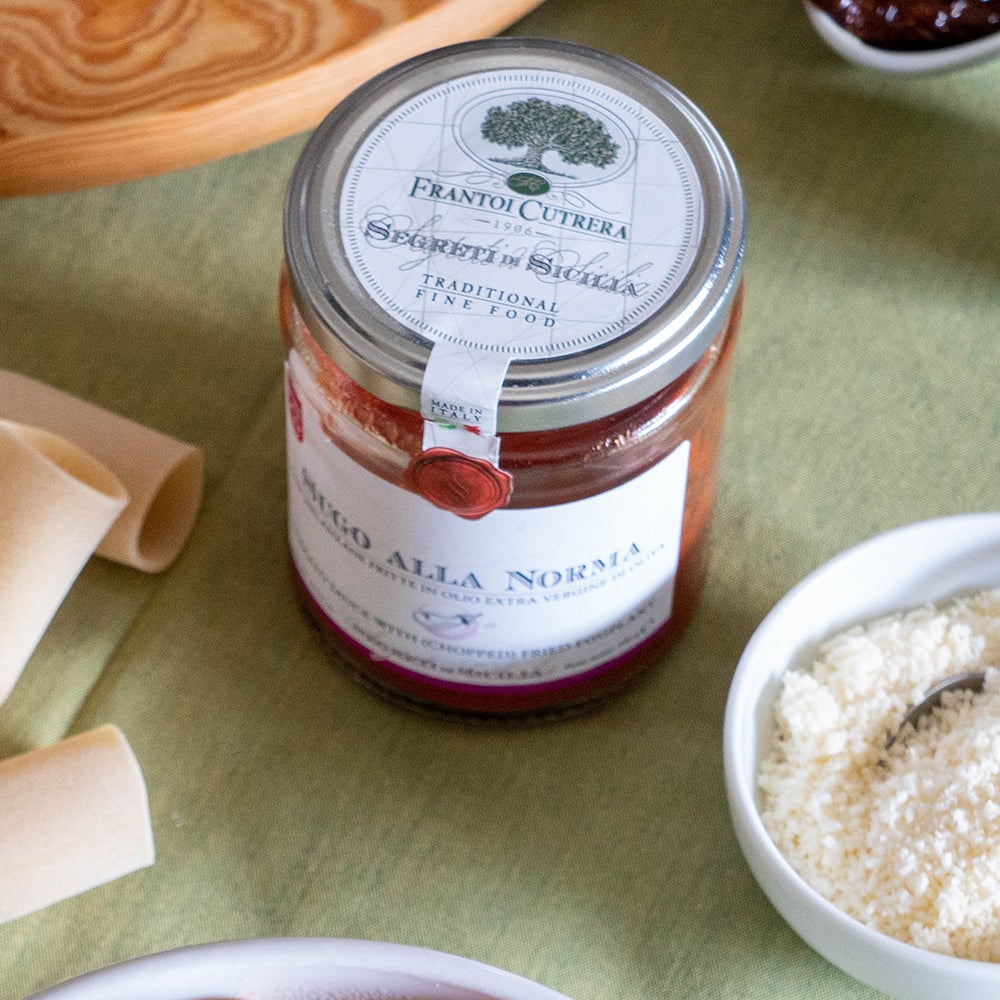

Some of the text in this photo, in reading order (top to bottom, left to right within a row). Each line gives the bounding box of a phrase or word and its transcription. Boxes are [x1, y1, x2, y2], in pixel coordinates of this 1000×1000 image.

[409, 176, 629, 241] FRANTOI CUTRERA
[494, 221, 534, 236] 1906
[365, 220, 497, 265] SEGRETI
[526, 253, 642, 298] SICILIA
[415, 289, 557, 328] FINE FOOD
[423, 273, 560, 314] TRADITIONAL
[430, 399, 484, 416] MADE IN
[430, 406, 483, 423] ITALY
[386, 550, 484, 591] ALLA
[505, 541, 641, 592] NORMA
